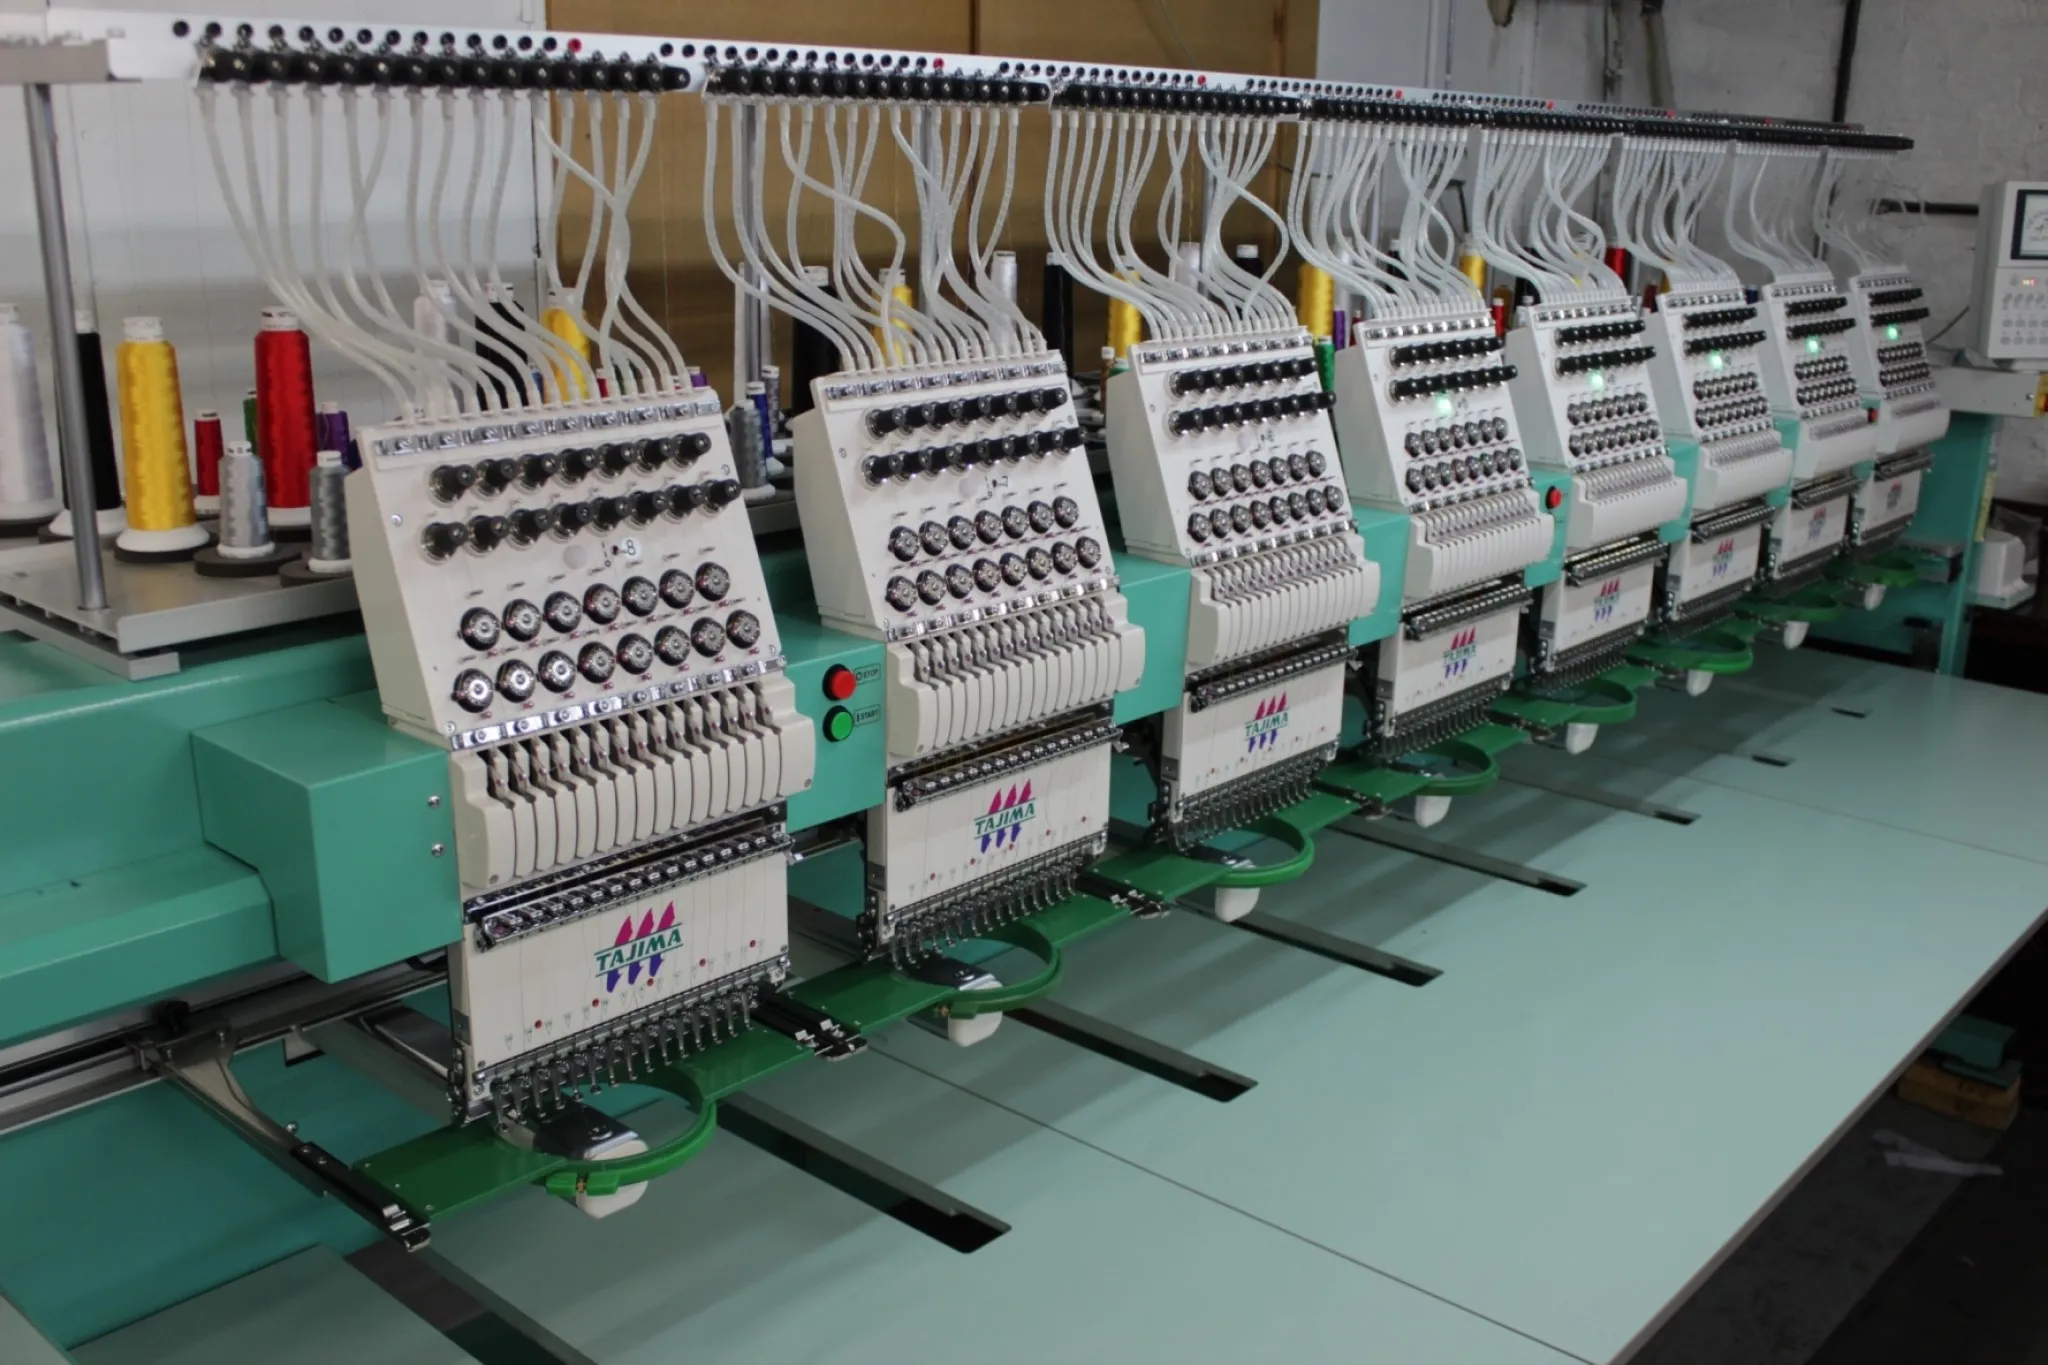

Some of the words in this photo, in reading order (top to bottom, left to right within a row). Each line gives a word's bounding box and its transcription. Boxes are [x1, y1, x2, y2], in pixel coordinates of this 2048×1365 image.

[626, 539, 637, 556] 8
[975, 801, 1035, 835] TAJIMA
[595, 927, 682, 972] TAJIMA
